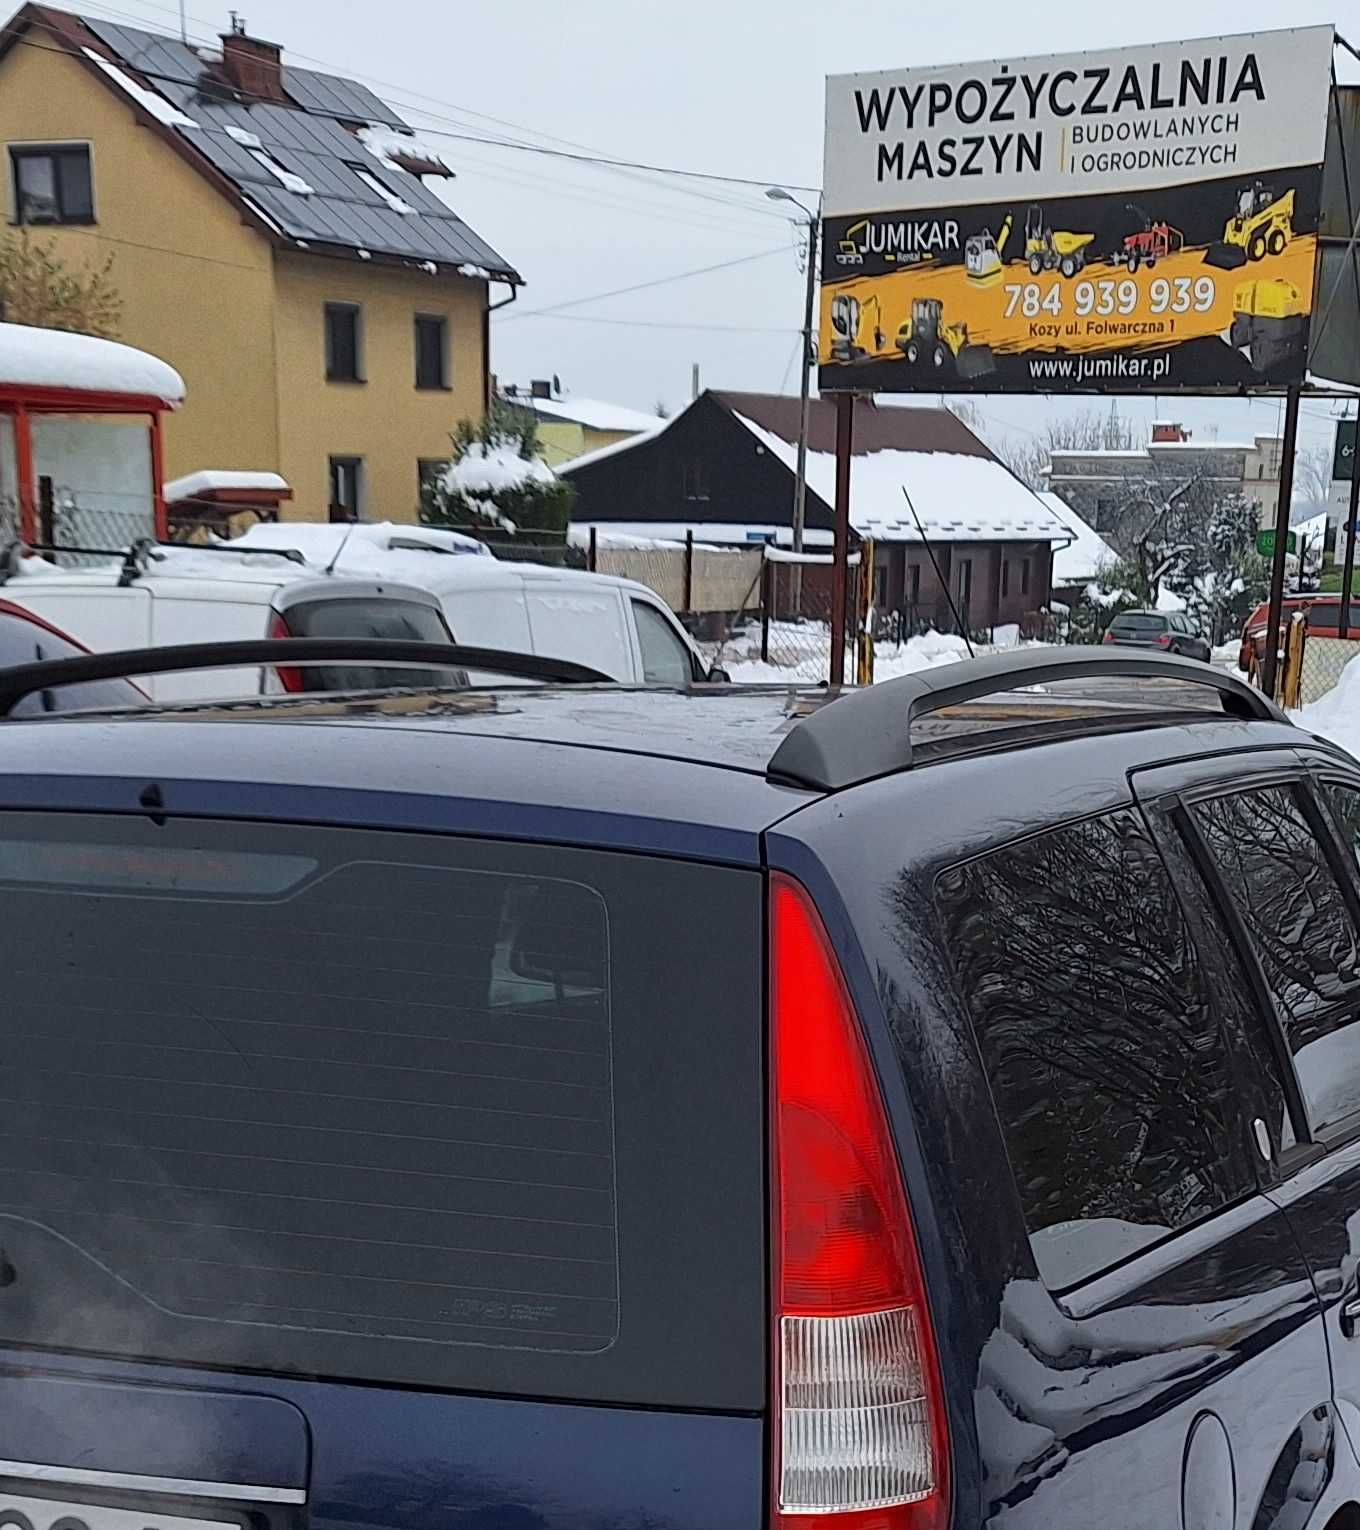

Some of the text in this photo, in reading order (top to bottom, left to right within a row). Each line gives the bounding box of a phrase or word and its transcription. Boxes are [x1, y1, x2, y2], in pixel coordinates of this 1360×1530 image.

[853, 54, 1266, 132] WYPOŻYCZALNIA
[1072, 113, 1239, 144] BUDOWLANYCH
[877, 131, 1043, 182] MASZYN
[1070, 144, 1237, 174] I OGRODNICZYCH
[859, 220, 960, 253] JUMIKAR
[1003, 276, 1216, 318] 784 939 939
[1029, 319, 1175, 338] Kozy ul. Folwarczna 1
[1029, 353, 1170, 383] www.jumikar.pl
